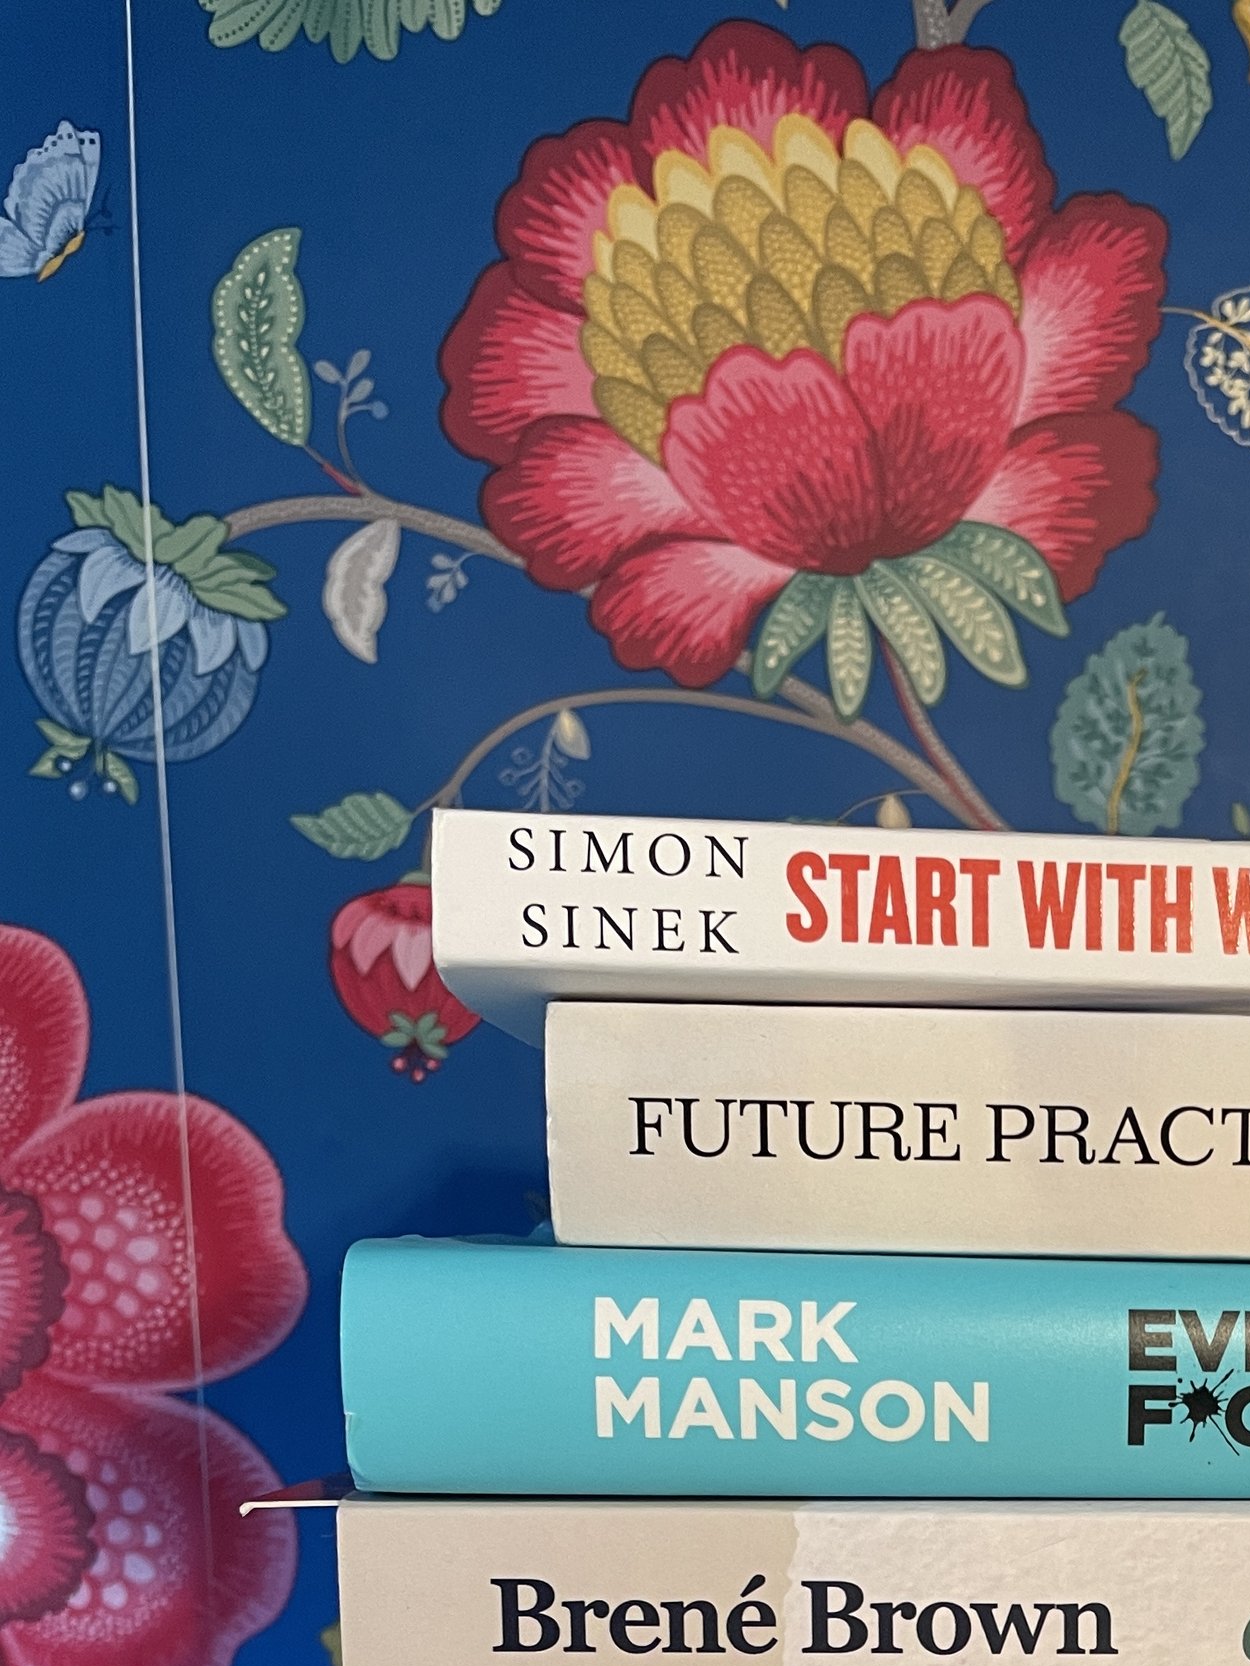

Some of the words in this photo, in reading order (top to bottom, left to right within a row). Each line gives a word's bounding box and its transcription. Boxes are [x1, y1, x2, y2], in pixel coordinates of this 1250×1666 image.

[507, 827, 749, 879] SIMON
[520, 903, 740, 954] SINEK
[786, 850, 1000, 947] START
[1018, 860, 1195, 954] WITH
[627, 1096, 963, 1162] FUTURE
[594, 1296, 858, 1364] MARK
[594, 1376, 990, 1442] MANSON
[490, 1574, 777, 1654] Brené
[801, 1579, 1118, 1656] Brown
